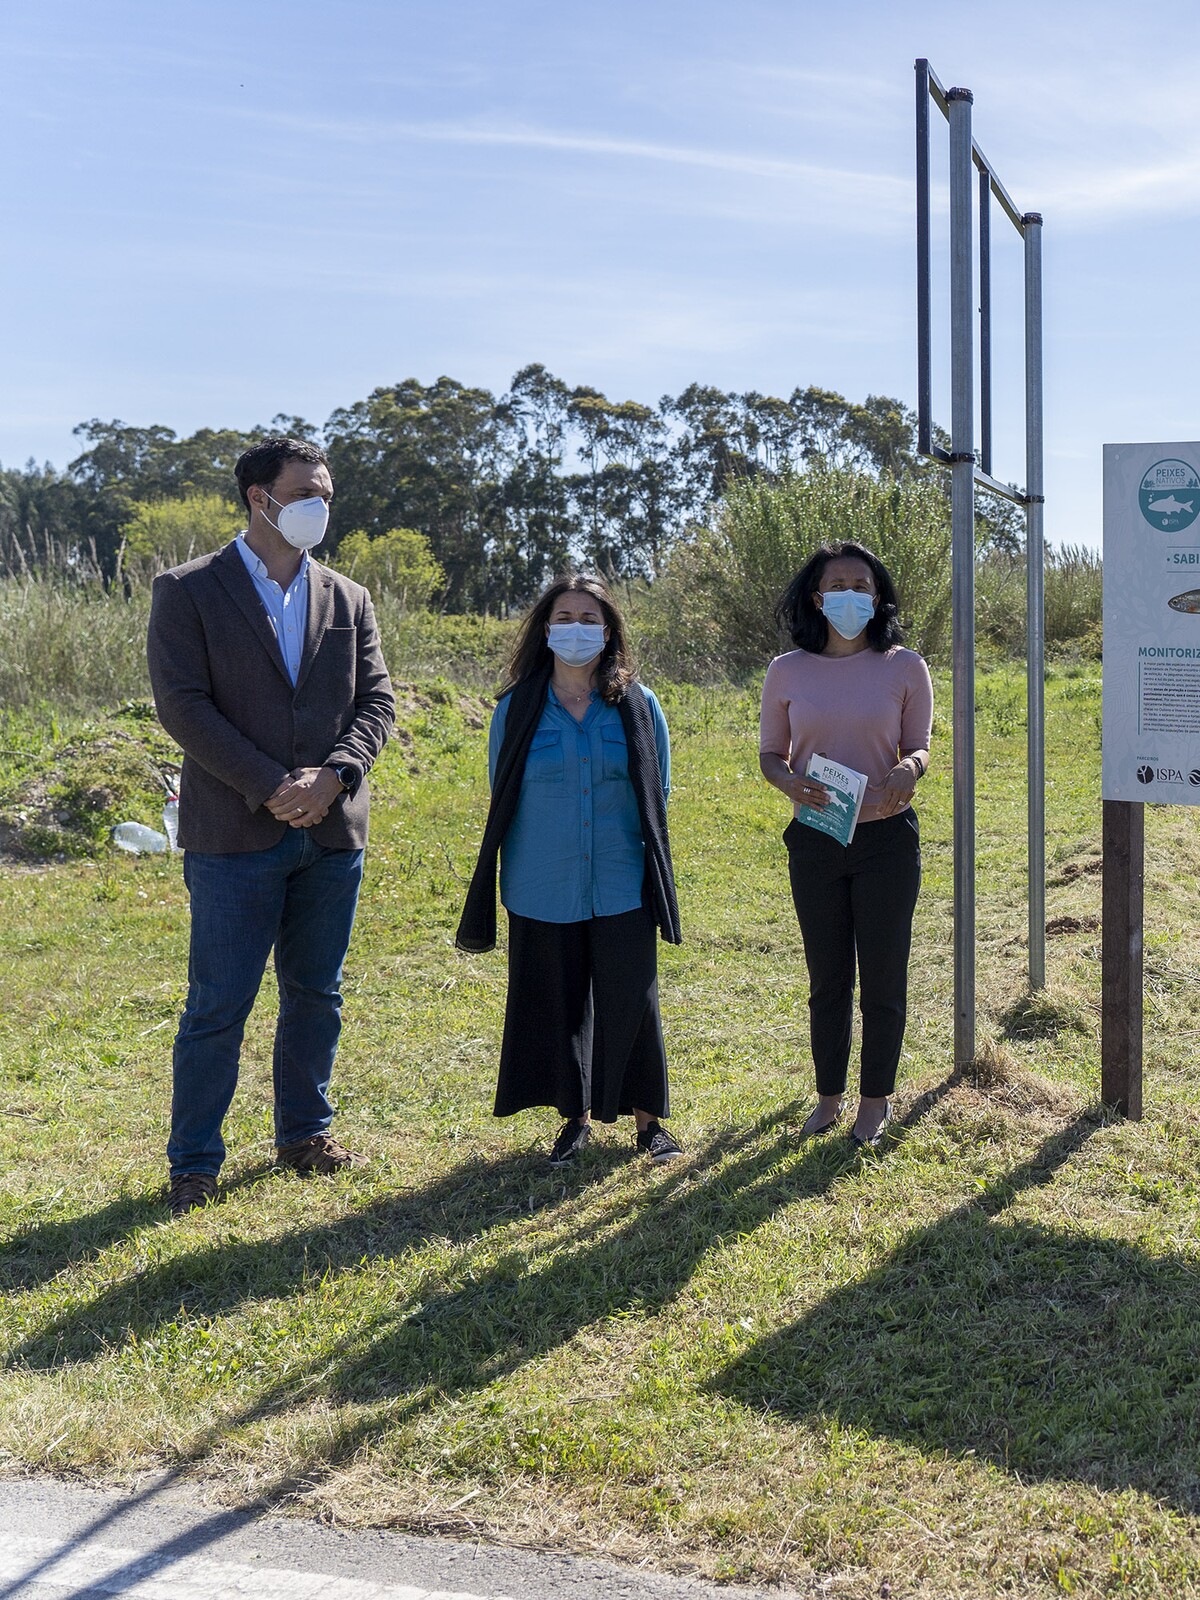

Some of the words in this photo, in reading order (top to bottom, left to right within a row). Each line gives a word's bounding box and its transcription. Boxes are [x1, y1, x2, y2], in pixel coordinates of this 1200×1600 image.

[1156, 467, 1186, 477] PEIXES
[824, 766, 849, 785] PEIXES
[1156, 767, 1184, 782] ISPA
